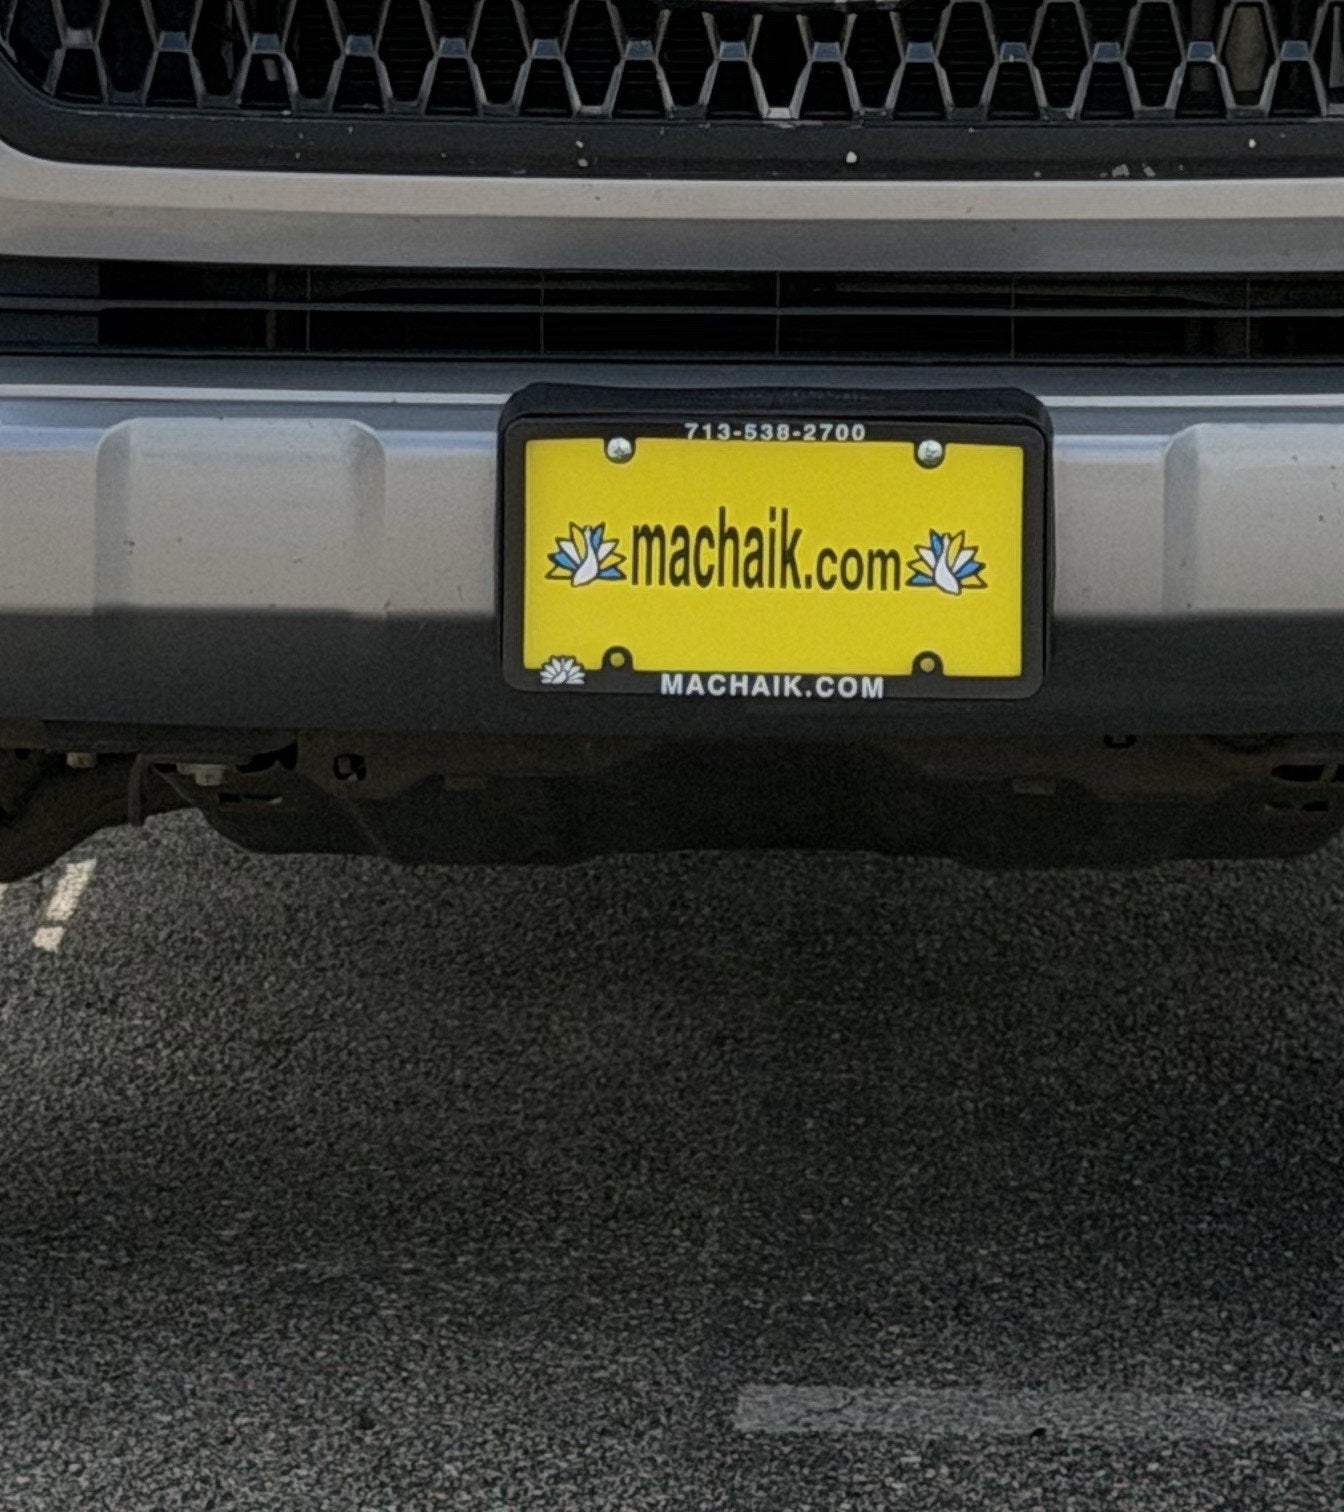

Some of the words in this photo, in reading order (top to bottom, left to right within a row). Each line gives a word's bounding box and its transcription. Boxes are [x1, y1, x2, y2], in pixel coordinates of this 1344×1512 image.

[685, 423, 867, 442] 713-538-2700
[632, 506, 901, 591] machaik.com
[660, 674, 886, 699] MACHAIK.COM
